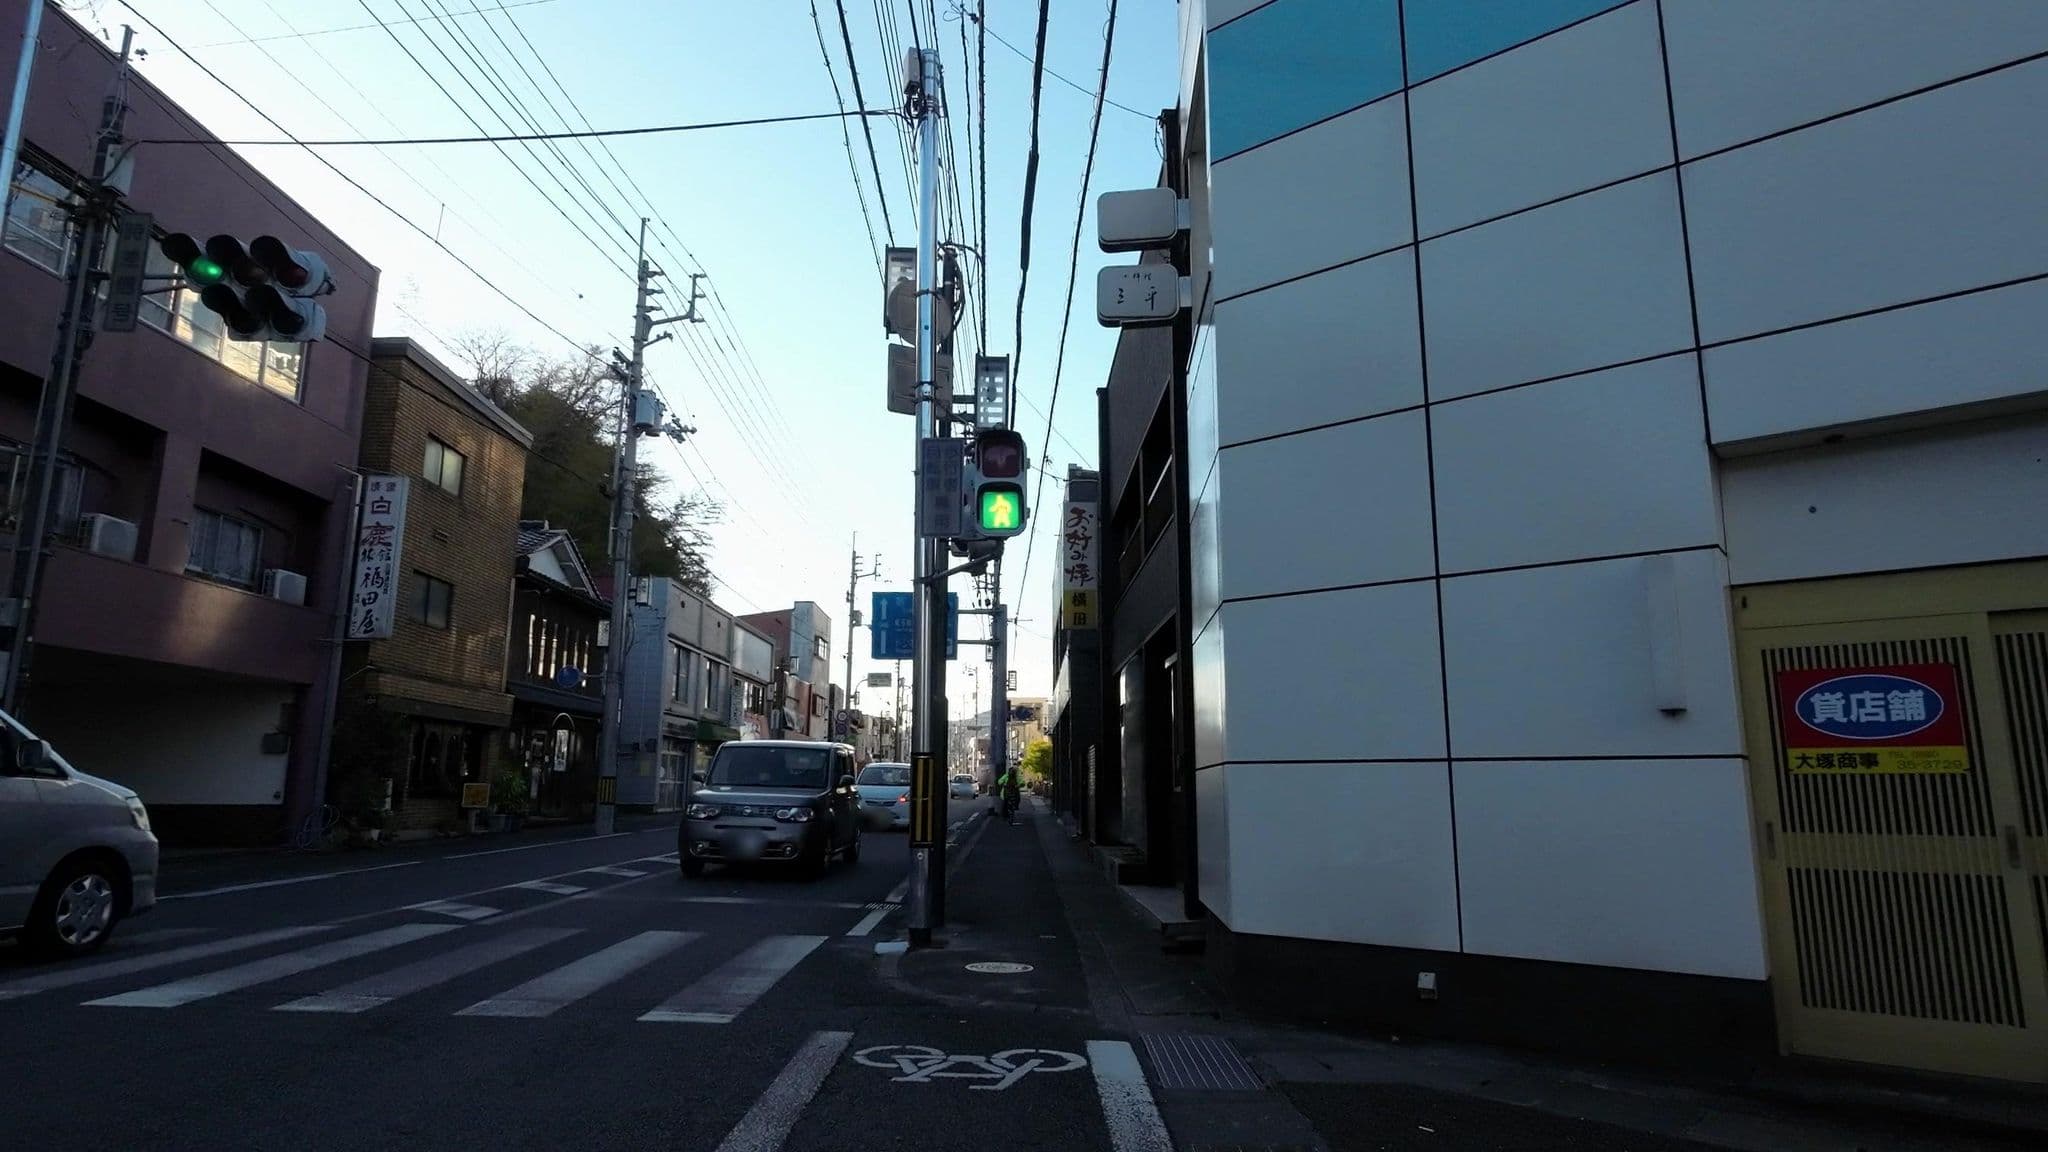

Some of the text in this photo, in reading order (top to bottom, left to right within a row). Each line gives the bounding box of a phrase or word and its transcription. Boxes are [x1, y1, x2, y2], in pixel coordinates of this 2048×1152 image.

[1810, 689, 1926, 723] 貸店舗
[1796, 752, 1880, 769] 大塚商事
